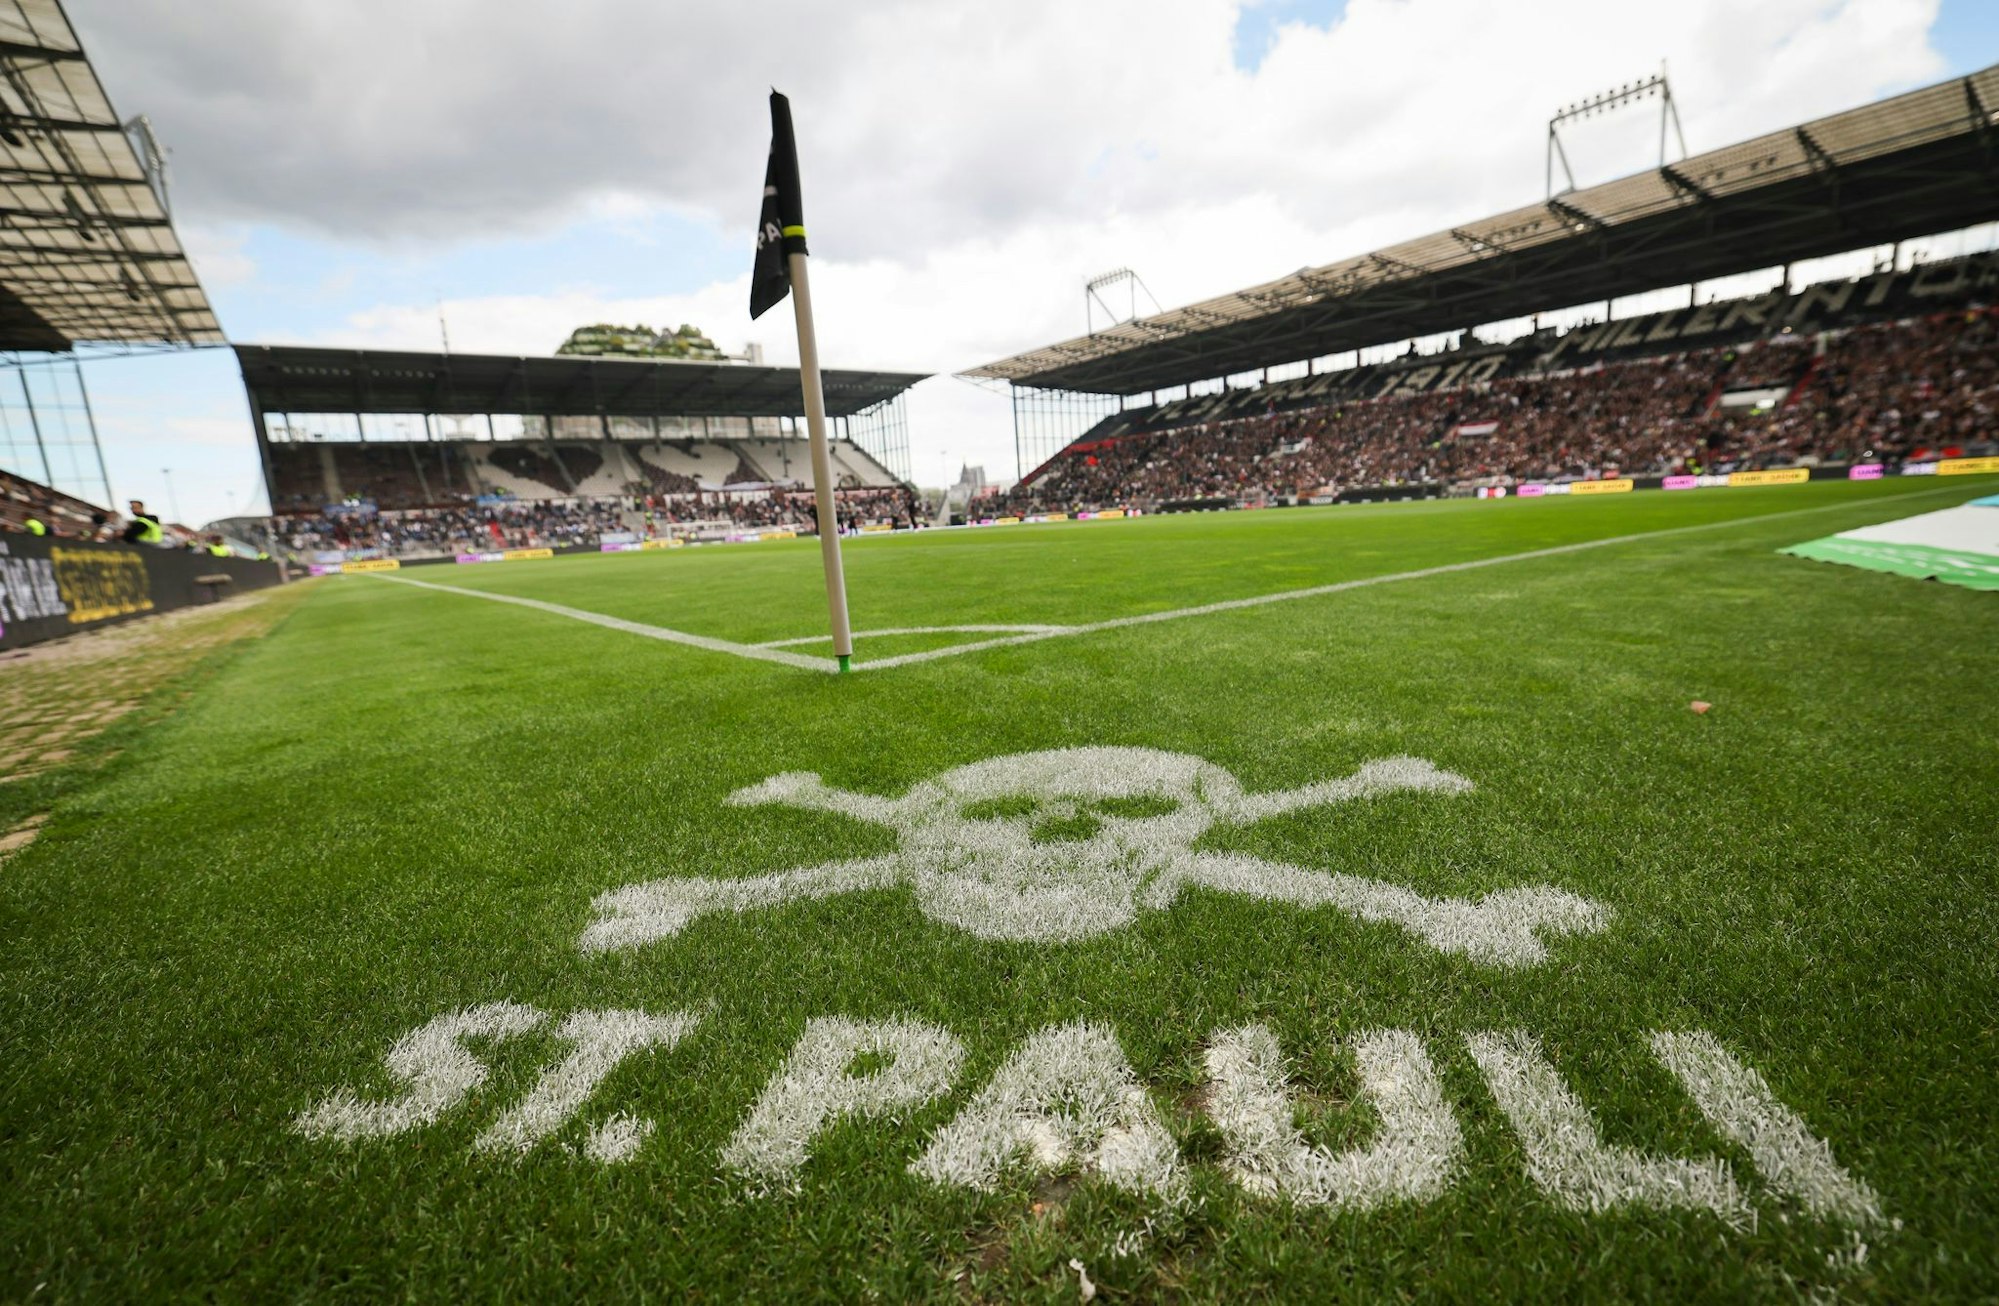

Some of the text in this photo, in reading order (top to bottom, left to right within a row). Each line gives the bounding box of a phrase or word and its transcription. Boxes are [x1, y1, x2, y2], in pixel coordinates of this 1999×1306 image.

[1376, 354, 1507, 398] 1910
[292, 1002, 1894, 1228] ST. PAULI
